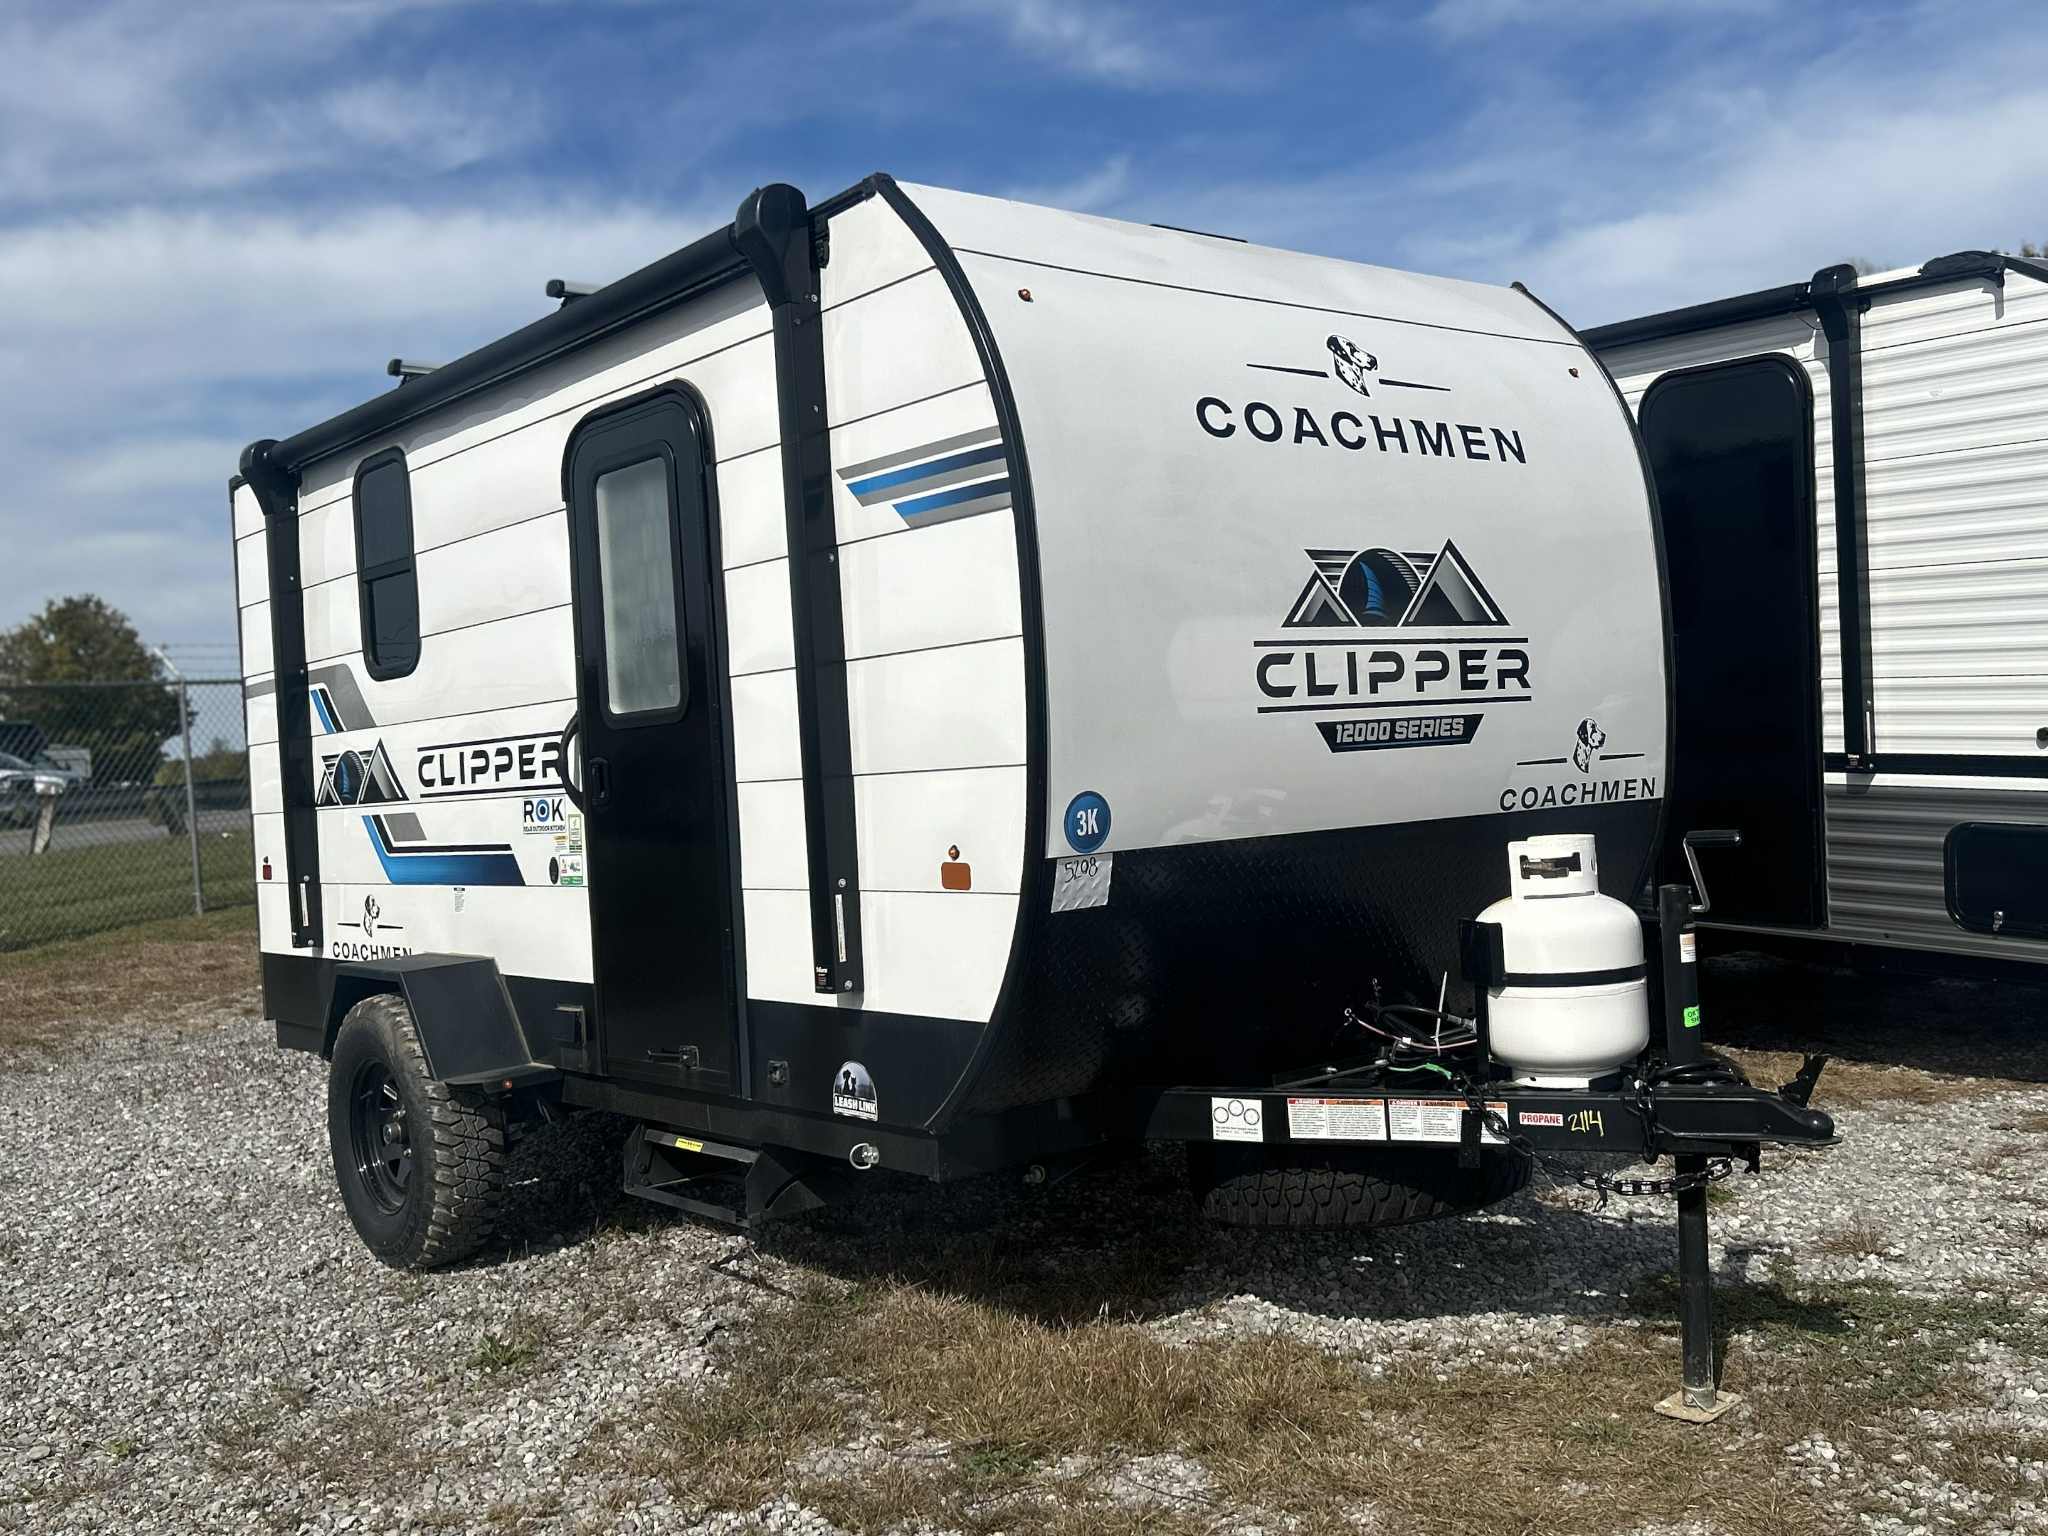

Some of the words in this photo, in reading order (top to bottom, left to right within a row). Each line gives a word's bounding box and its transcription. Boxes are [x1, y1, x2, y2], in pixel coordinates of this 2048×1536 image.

[1195, 396, 1527, 464] COACHMEN
[1256, 648, 1532, 698] CLIPPER
[1336, 722, 1391, 743] 12000
[1394, 717, 1465, 739] SERIES
[418, 741, 562, 788] CLIPPER
[1499, 777, 1657, 812] COACHMEN
[523, 798, 565, 823] ROK
[1076, 807, 1099, 836] 3K
[834, 1095, 858, 1111] LEASH
[858, 1100, 876, 1114] LINK
[1521, 1113, 1561, 1124] PROPANE
